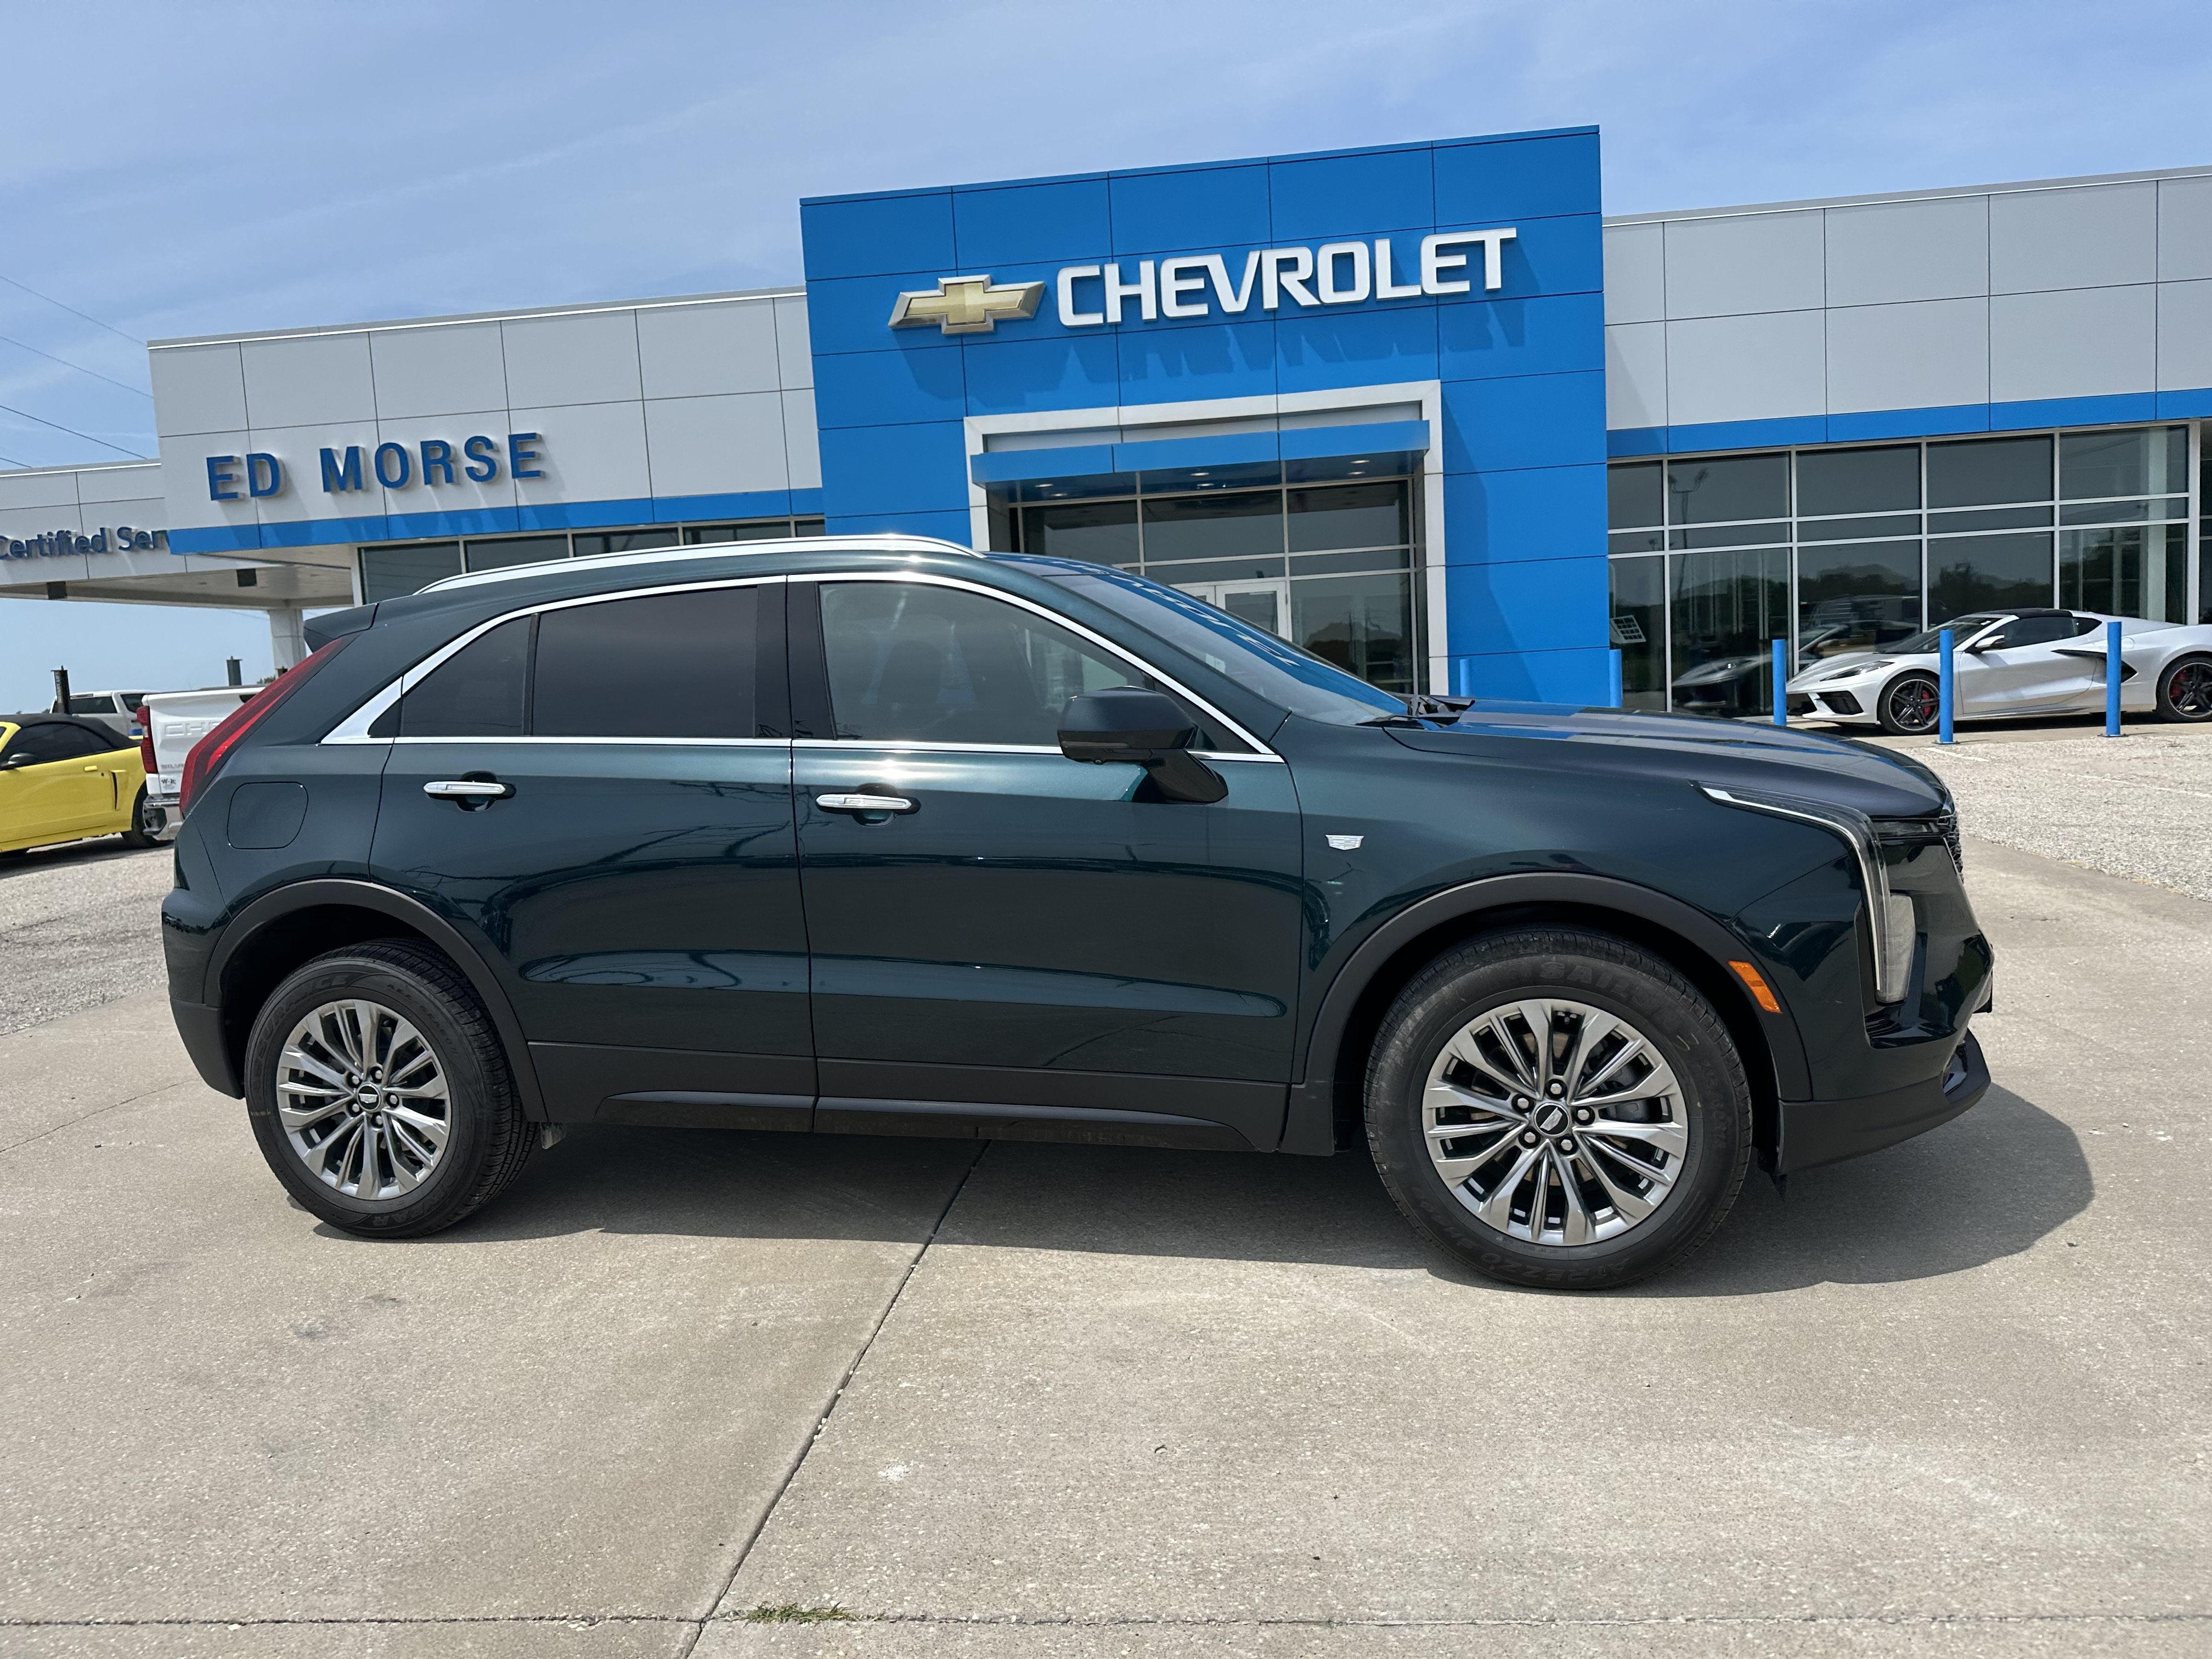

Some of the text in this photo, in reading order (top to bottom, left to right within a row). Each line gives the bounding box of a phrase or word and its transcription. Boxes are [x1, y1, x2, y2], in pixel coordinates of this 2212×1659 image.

[1057, 228, 1517, 328] CHEVROLET
[206, 432, 543, 501] ED MORSE
